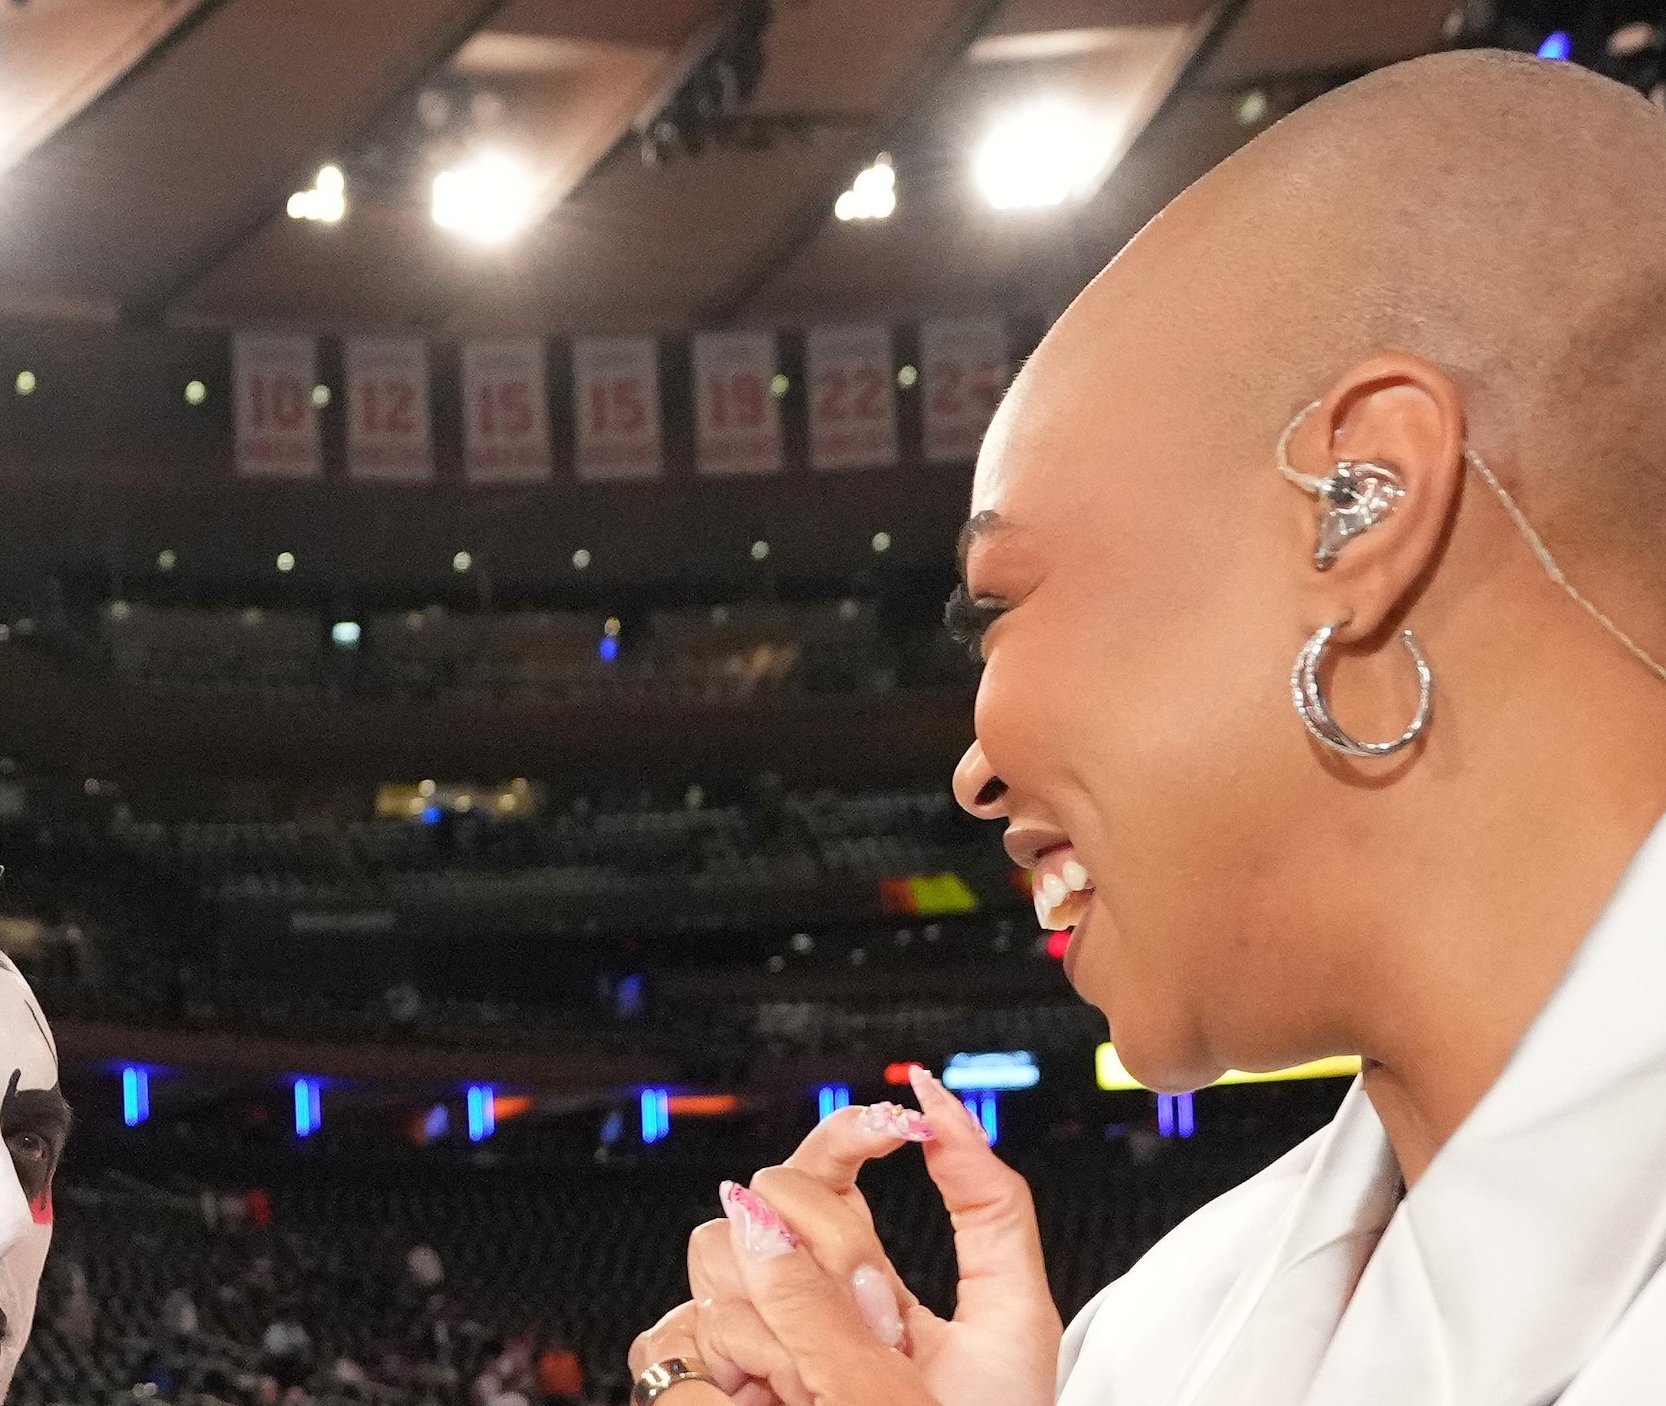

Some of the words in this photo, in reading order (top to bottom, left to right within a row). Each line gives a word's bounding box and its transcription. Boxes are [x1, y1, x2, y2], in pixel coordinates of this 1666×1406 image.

[359, 379, 417, 433] 12
[478, 383, 535, 436] 15
[590, 379, 647, 434] 15
